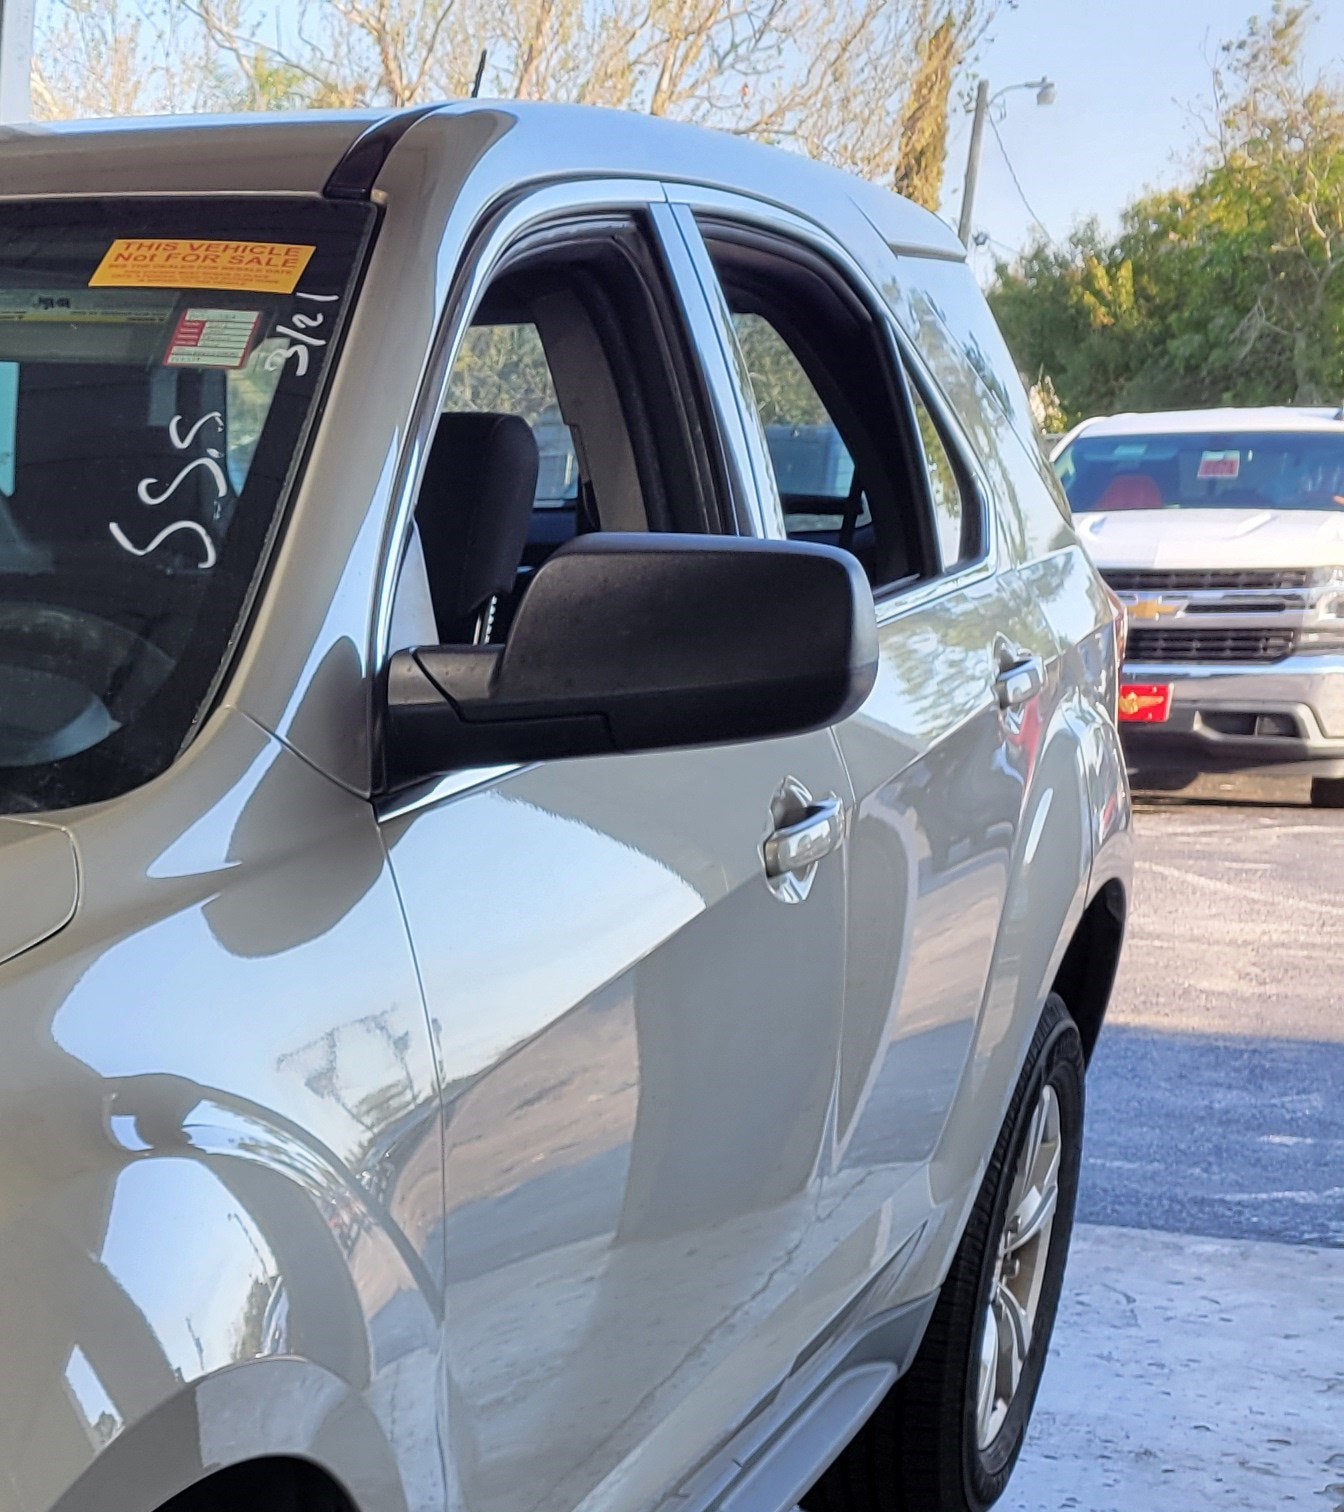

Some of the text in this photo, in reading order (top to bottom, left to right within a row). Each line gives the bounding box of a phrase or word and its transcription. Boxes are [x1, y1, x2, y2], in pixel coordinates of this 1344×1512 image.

[122, 241, 301, 258] THIS VEHICLE
[114, 252, 299, 269] Not FOR SALE
